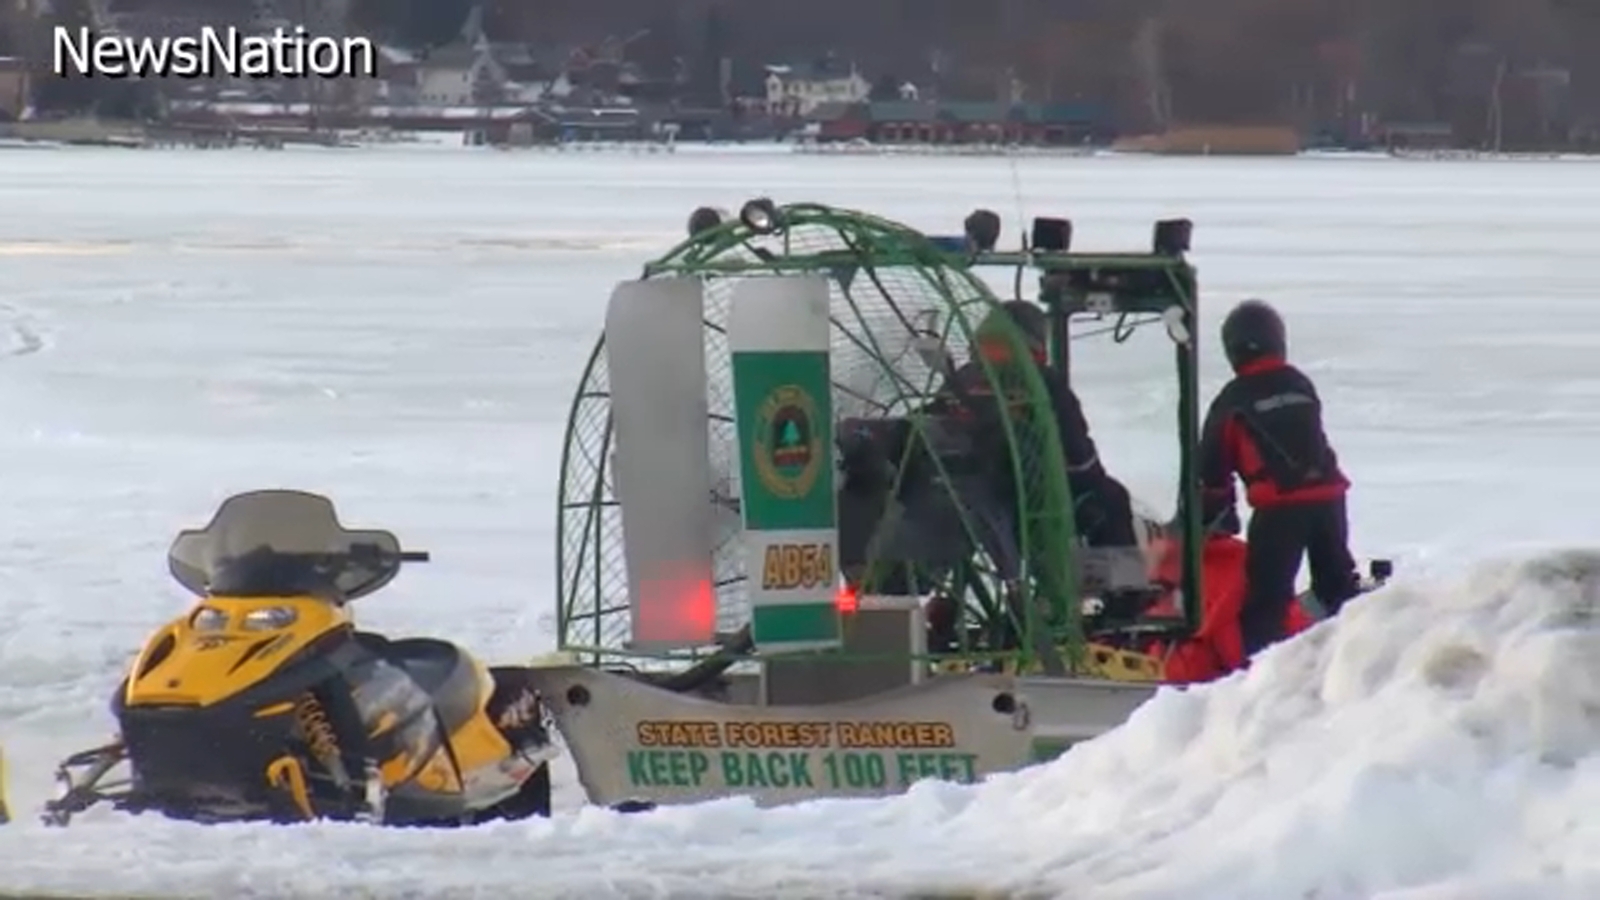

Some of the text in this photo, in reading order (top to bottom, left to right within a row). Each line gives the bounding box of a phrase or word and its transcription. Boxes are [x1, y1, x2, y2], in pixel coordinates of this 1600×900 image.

[762, 544, 833, 590] AB54
[637, 720, 955, 747] STATE FOREST RANGER
[627, 752, 708, 787] KEEP
[721, 752, 813, 788] BACK
[823, 753, 885, 788] 100
